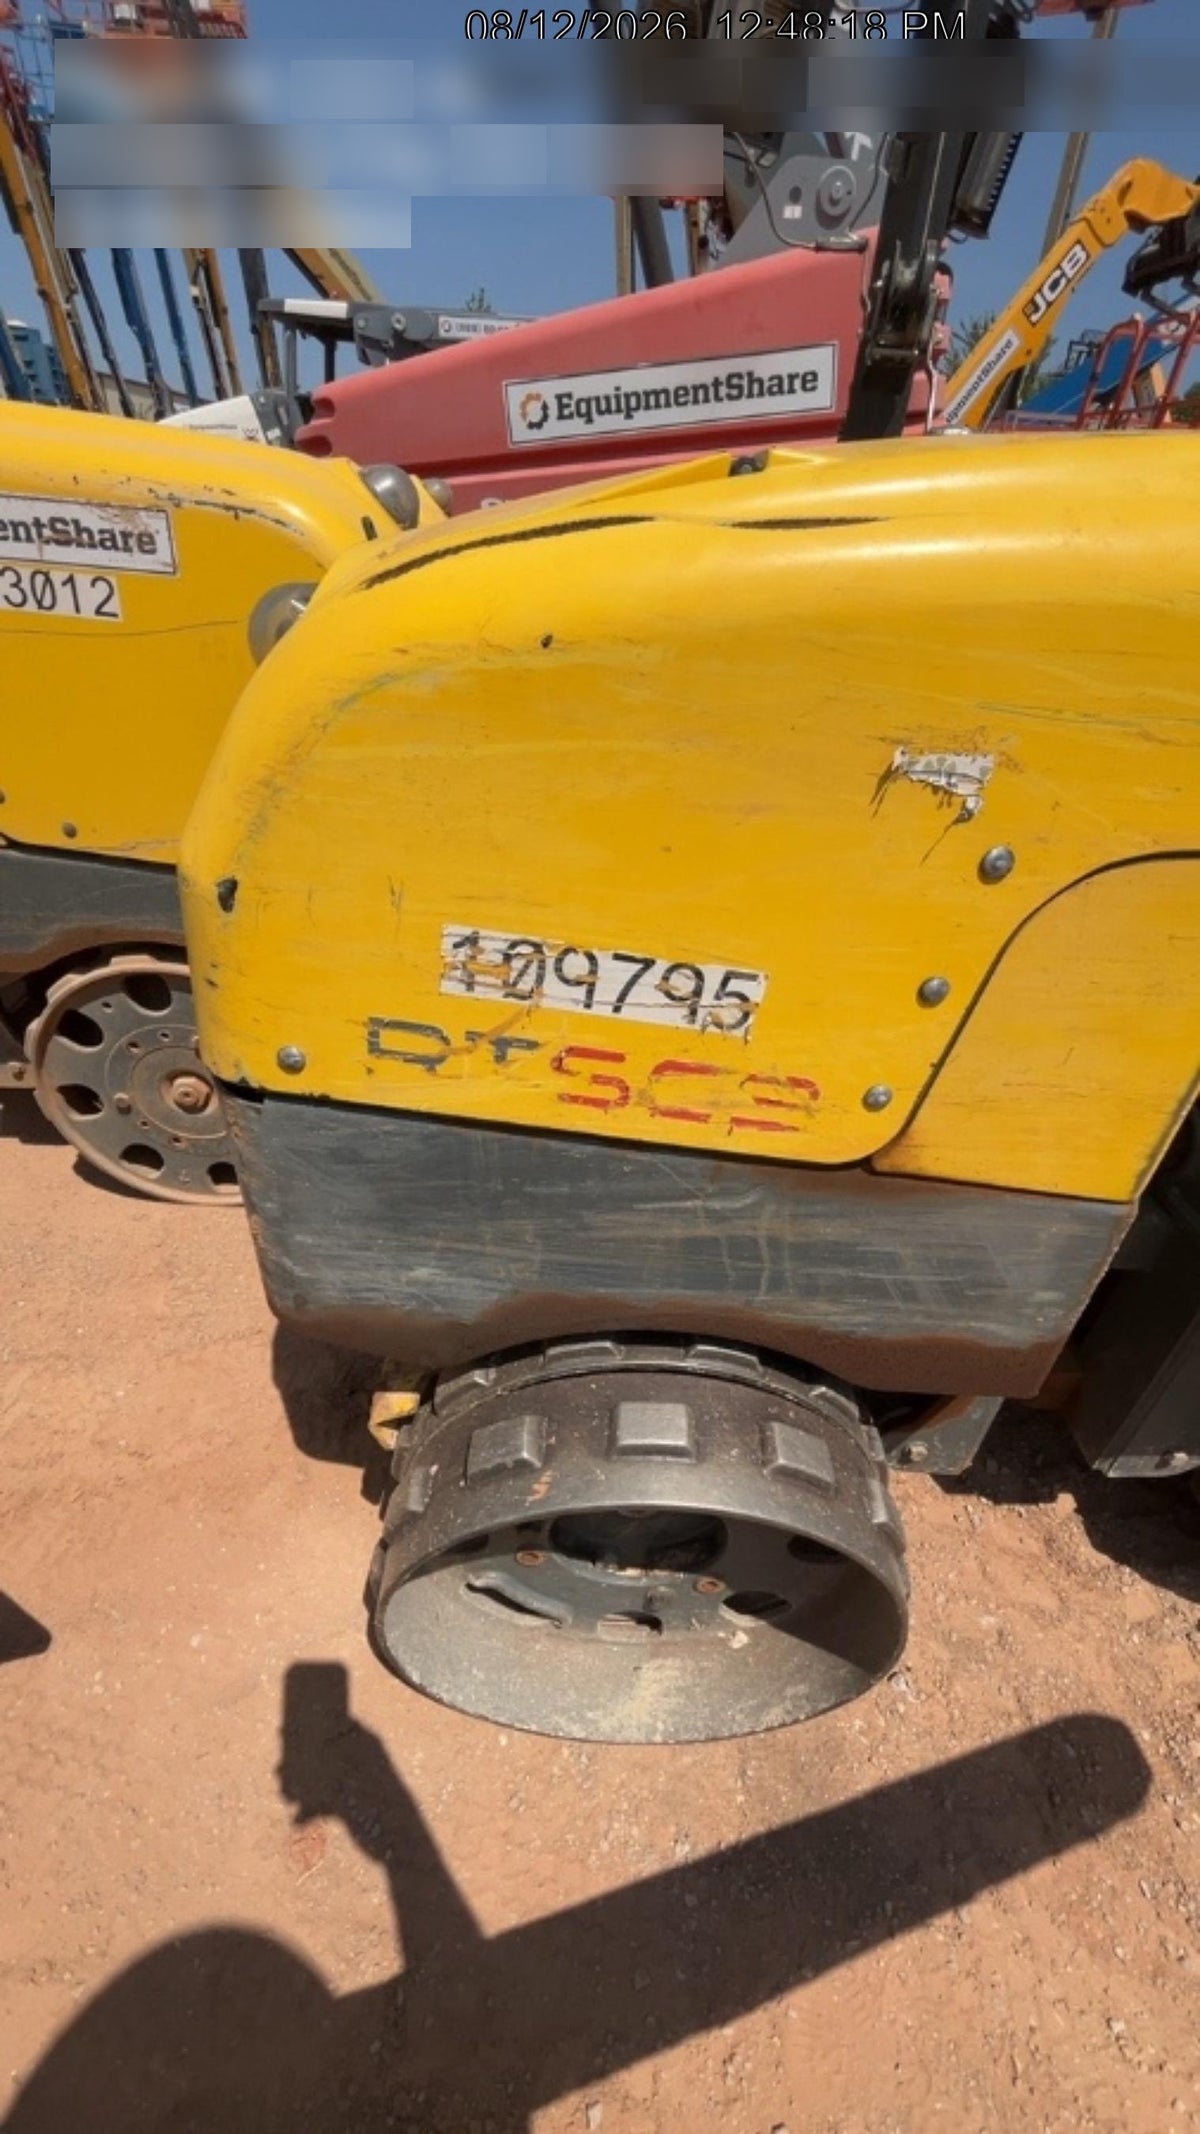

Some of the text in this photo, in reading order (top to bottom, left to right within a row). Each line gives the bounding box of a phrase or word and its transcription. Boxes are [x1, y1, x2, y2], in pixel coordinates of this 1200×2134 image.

[1027, 242, 1088, 323] JCB
[555, 369, 819, 425] EquipmentShare
[0, 566, 120, 619] 3012
[451, 929, 760, 1032] 109795
